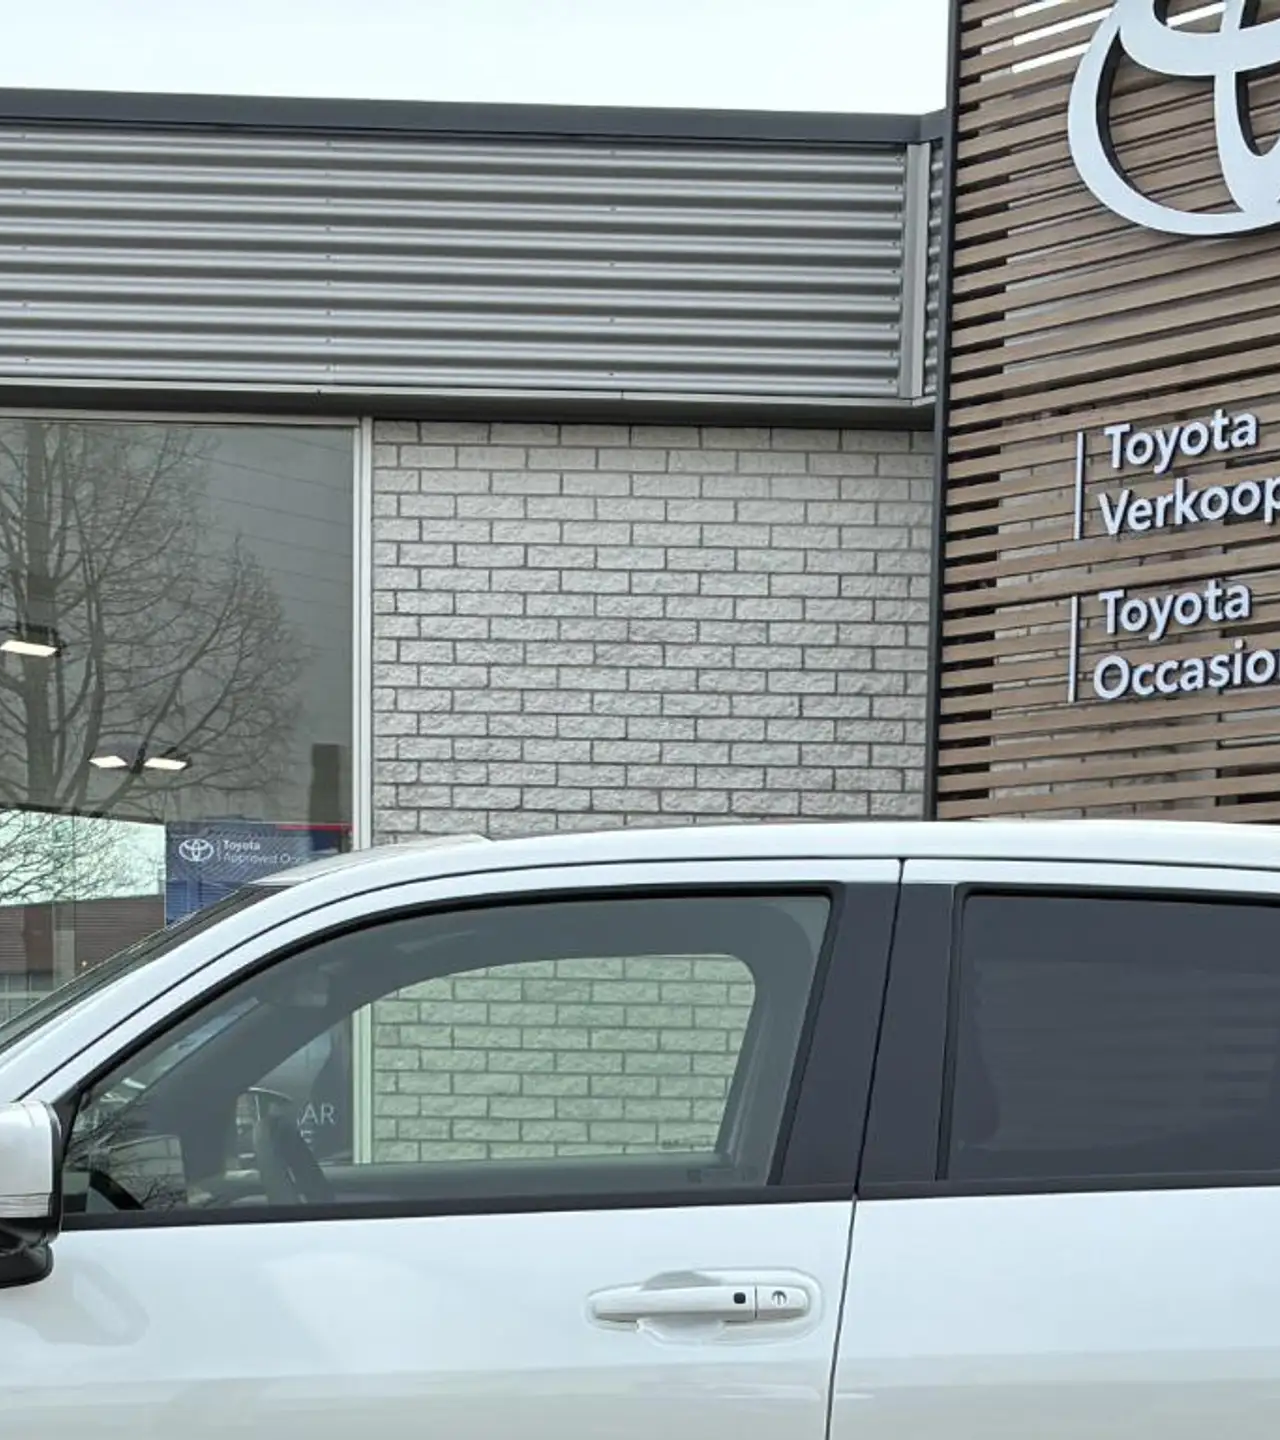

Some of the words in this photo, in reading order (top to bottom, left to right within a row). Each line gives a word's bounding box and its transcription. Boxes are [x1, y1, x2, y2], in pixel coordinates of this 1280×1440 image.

[1103, 408, 1259, 474] Toyota
[1098, 579, 1252, 640] Toyota
[223, 840, 261, 852] Toyota
